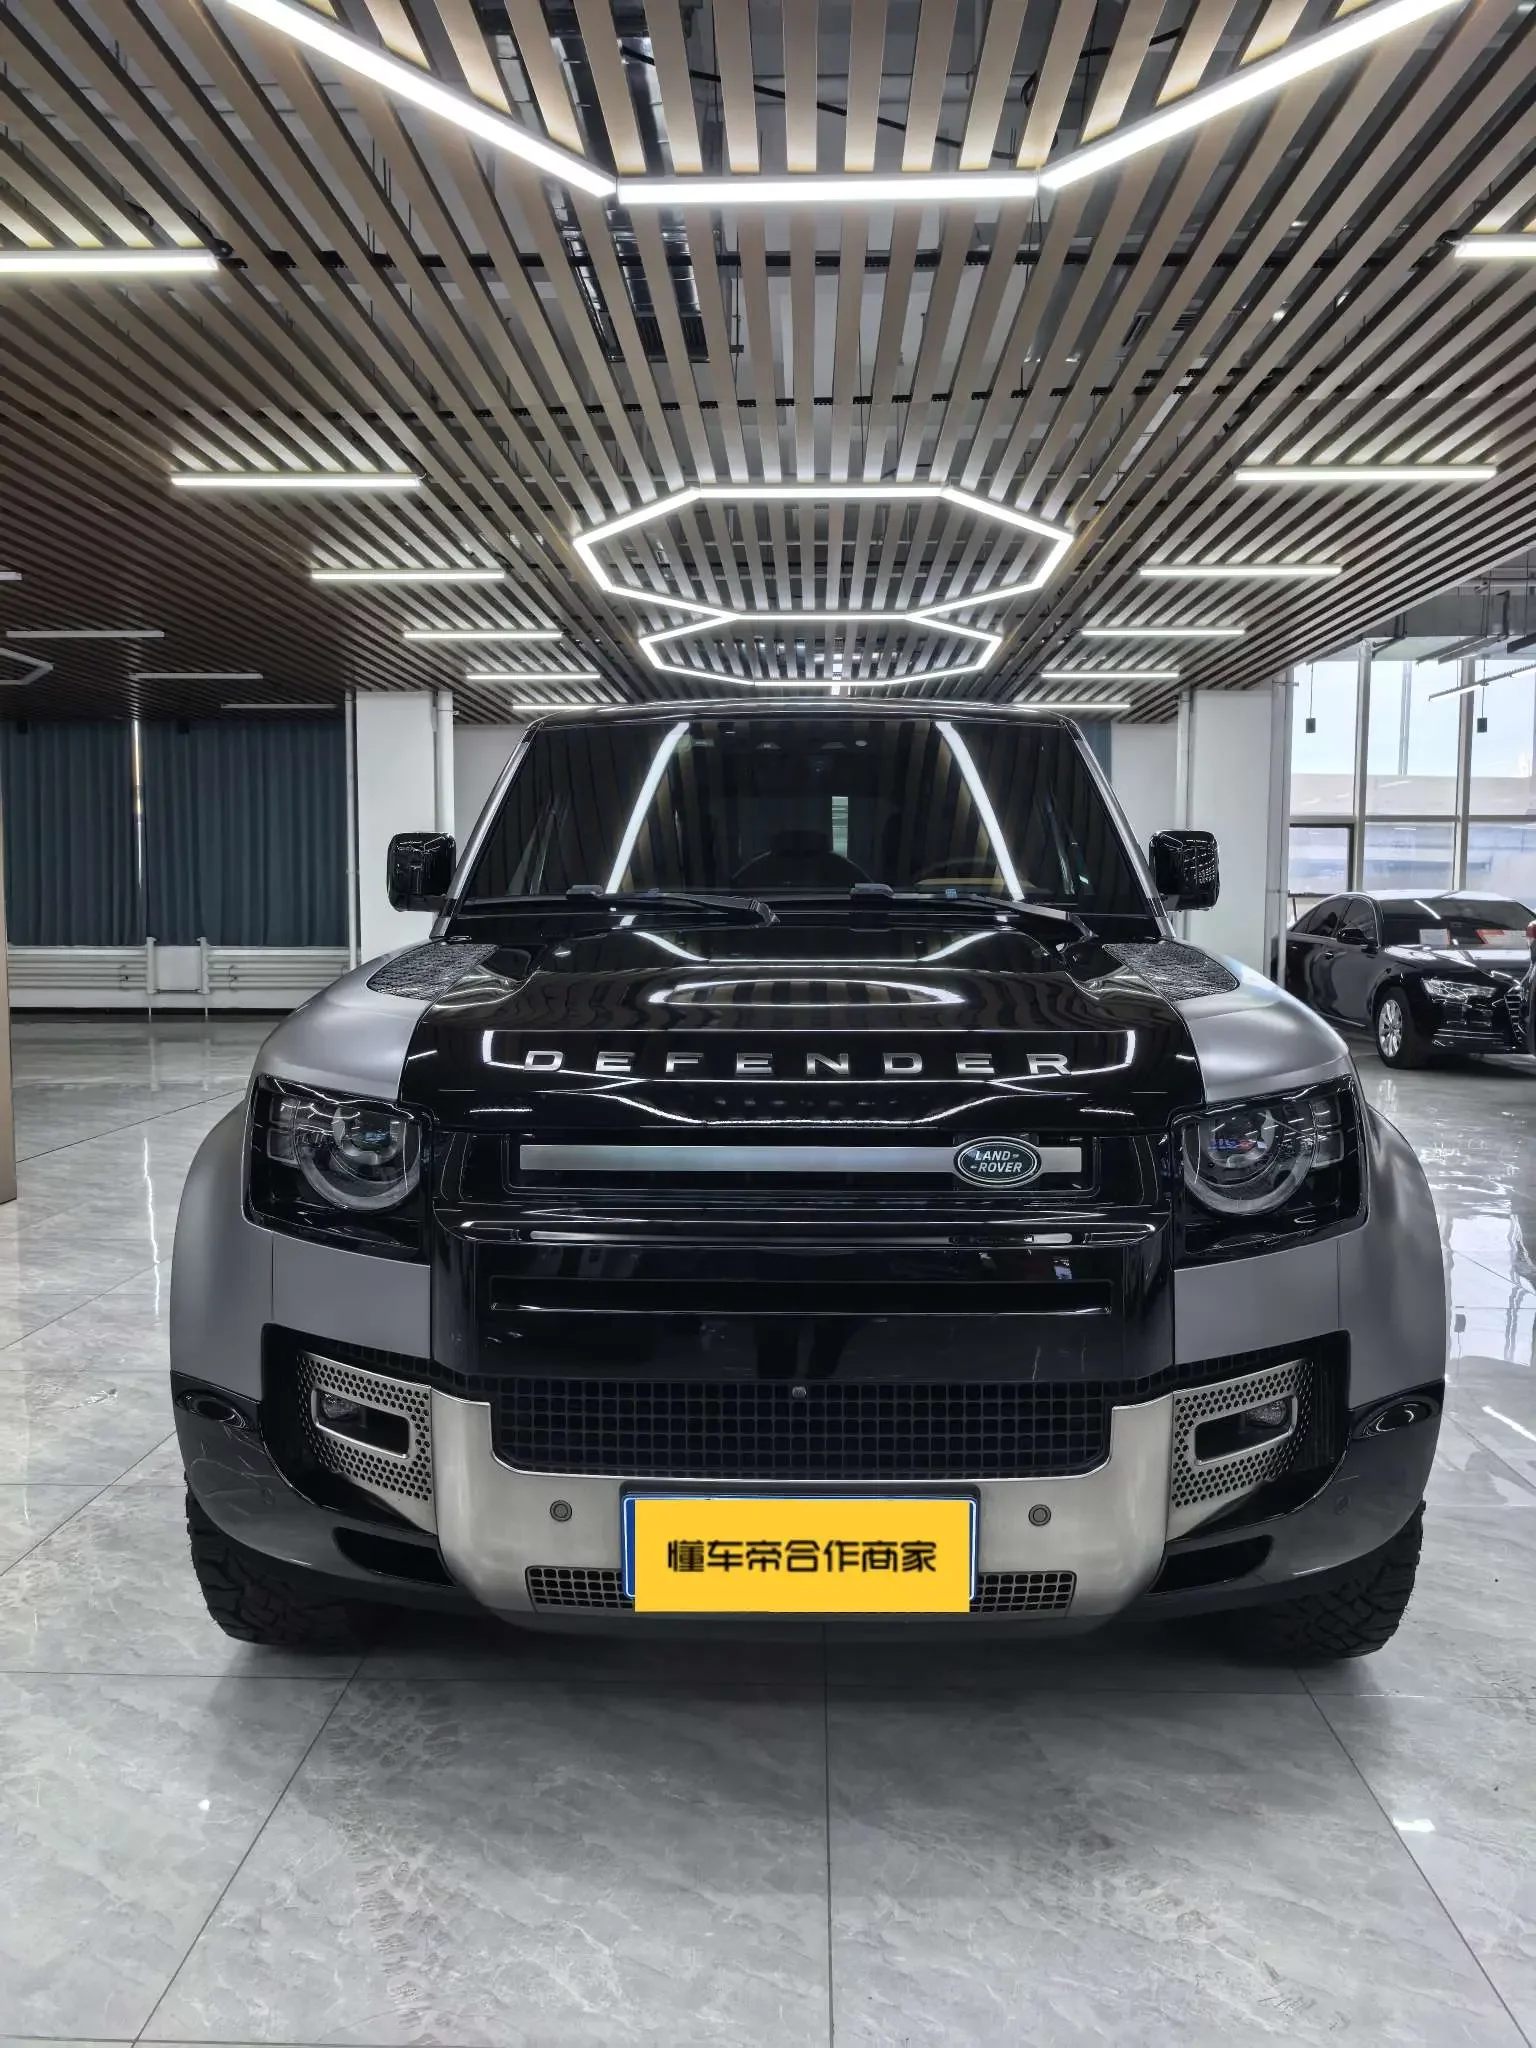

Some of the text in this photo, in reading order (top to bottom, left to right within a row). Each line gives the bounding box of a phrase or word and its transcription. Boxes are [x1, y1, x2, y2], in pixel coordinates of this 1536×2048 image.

[523, 1050, 1073, 1076] DEFENDER
[974, 1150, 1011, 1161] LAND
[977, 1162, 1023, 1173] ROVER
